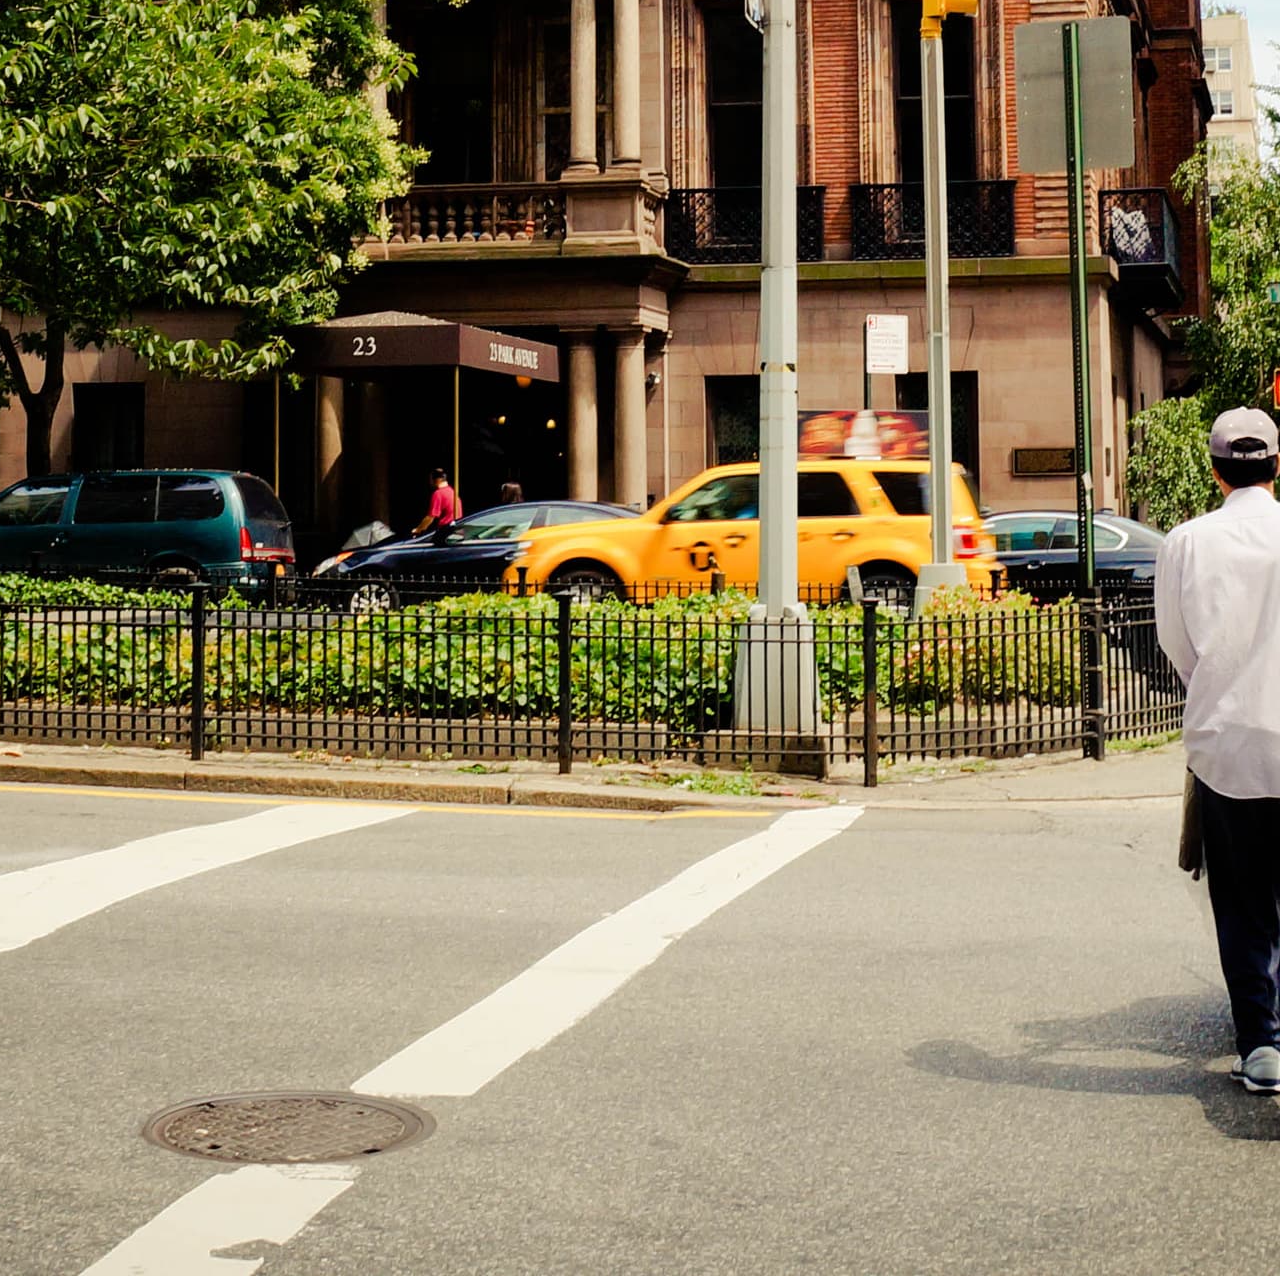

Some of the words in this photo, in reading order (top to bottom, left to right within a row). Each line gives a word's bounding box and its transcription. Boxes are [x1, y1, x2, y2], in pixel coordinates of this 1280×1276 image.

[352, 336, 377, 356] 23
[498, 344, 515, 365] PARK
[514, 347, 539, 370] AVENUE
